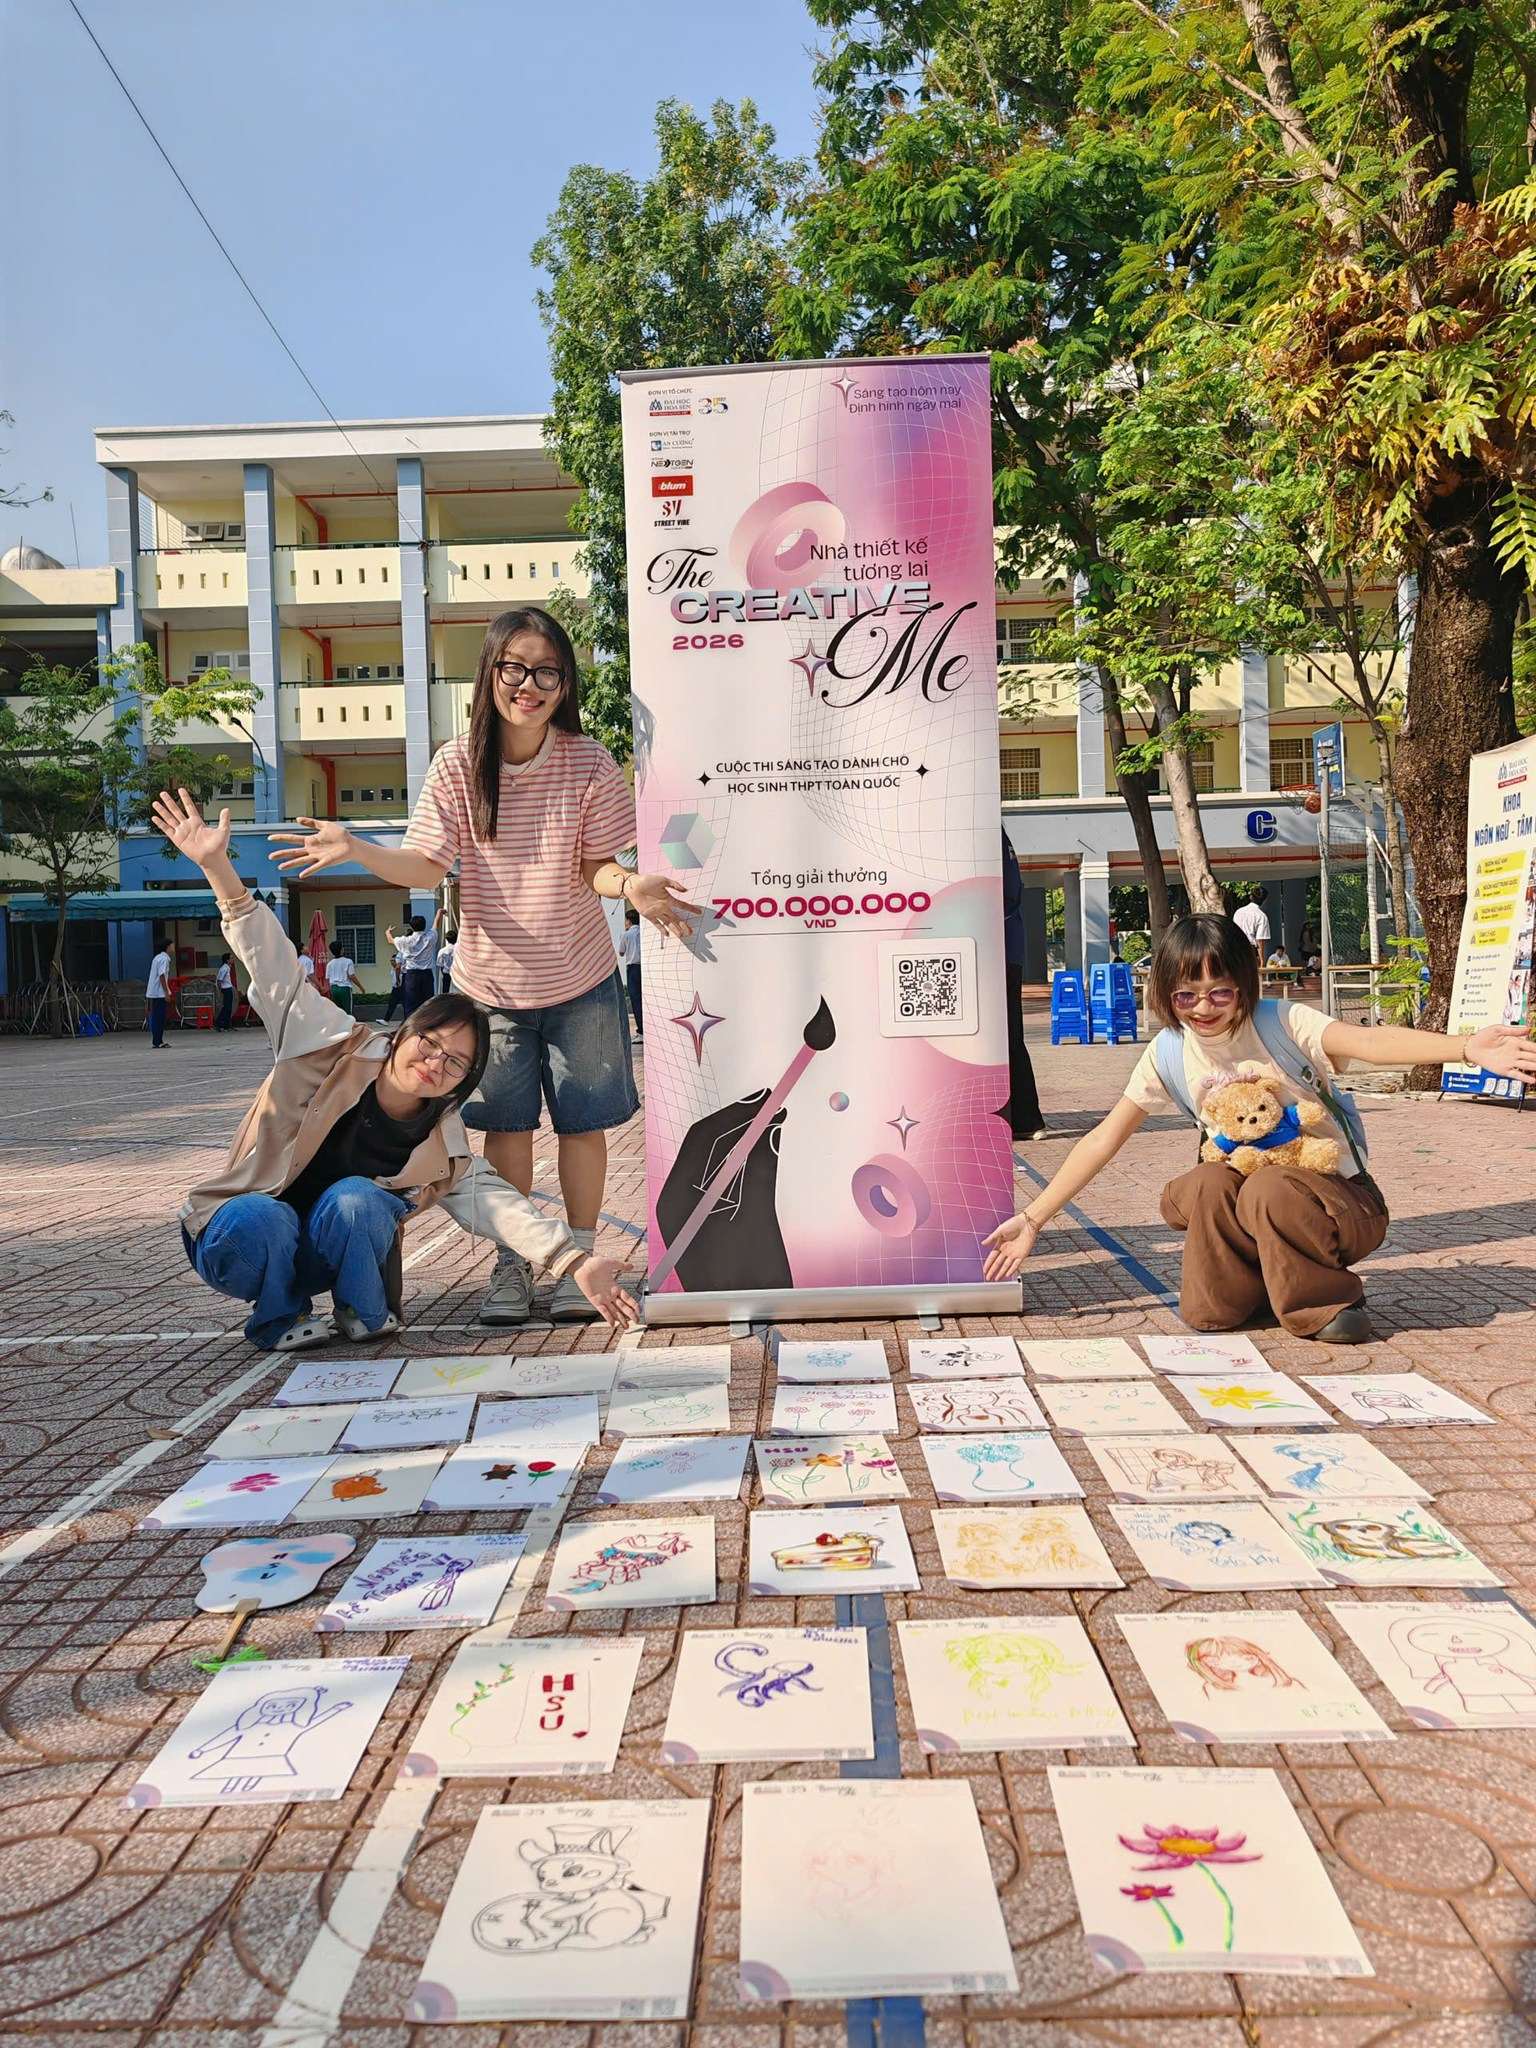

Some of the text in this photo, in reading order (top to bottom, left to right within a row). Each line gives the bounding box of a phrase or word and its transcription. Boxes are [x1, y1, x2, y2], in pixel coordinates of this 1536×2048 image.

[940, 386, 961, 396] nay
[939, 398, 961, 409] mai
[660, 481, 687, 491] blum
[654, 519, 675, 527] STREET
[810, 536, 928, 560] Nhà thiết kế
[647, 547, 718, 594] The
[843, 560, 929, 581] tương lai
[670, 581, 931, 624] CREATIVE
[672, 634, 744, 650] 2026
[821, 602, 978, 708] Me
[716, 756, 910, 775] CUỘC THI SÁNG TẠO DÀNH CHO
[728, 775, 901, 796] HỌC SINH THPT TOÀN QUỐC
[1502, 792, 1521, 813] KHOA
[1247, 810, 1277, 843] C
[1474, 823, 1494, 847] NGÔN
[1517, 813, 1533, 837] TÂM
[751, 867, 888, 888] Tổng giải thưởng
[712, 891, 931, 920] 700.000.000
[803, 919, 837, 929] VND
